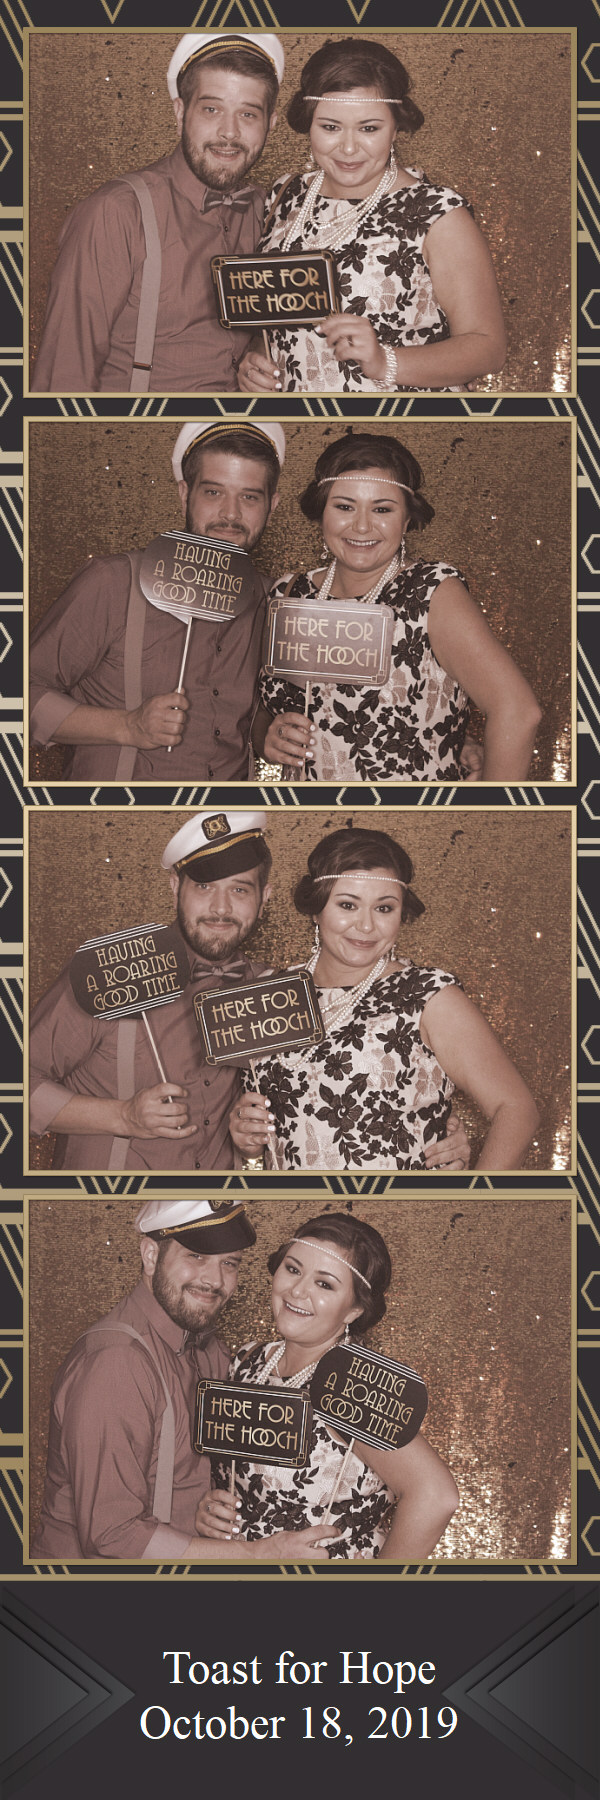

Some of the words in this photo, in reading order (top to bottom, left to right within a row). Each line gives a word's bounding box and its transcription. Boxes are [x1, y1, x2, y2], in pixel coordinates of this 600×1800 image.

[229, 270, 275, 290] HERE
[279, 267, 320, 288] FOR
[227, 294, 261, 314] THE
[266, 290, 329, 313] HOOCH
[173, 542, 231, 571] HAVING
[153, 559, 165, 577] A
[170, 562, 243, 594] ROARING
[152, 580, 197, 604] GOOD
[201, 589, 237, 613] TIME
[284, 615, 329, 638] HERE
[335, 620, 374, 642] FOR
[277, 641, 310, 663] THE
[316, 644, 378, 668] HOOCH
[95, 935, 156, 968] HAVING
[86, 974, 99, 993] A
[102, 951, 178, 988] ROARING
[93, 985, 139, 1011] GOOD
[142, 972, 180, 998] TIME
[212, 997, 257, 1024] HERE
[261, 989, 300, 1013] FOR
[210, 1024, 246, 1049] THE
[250, 1010, 311, 1040] HOOCH
[347, 1356, 407, 1397] HAVING
[211, 1397, 252, 1420] HERE
[258, 1403, 294, 1425] FOR
[324, 1372, 338, 1391] A
[341, 1378, 414, 1425] ROARING
[320, 1393, 363, 1424] GOOD
[366, 1413, 403, 1444] TIME
[205, 1420, 235, 1442] THE
[241, 1425, 298, 1451] HOOCH
